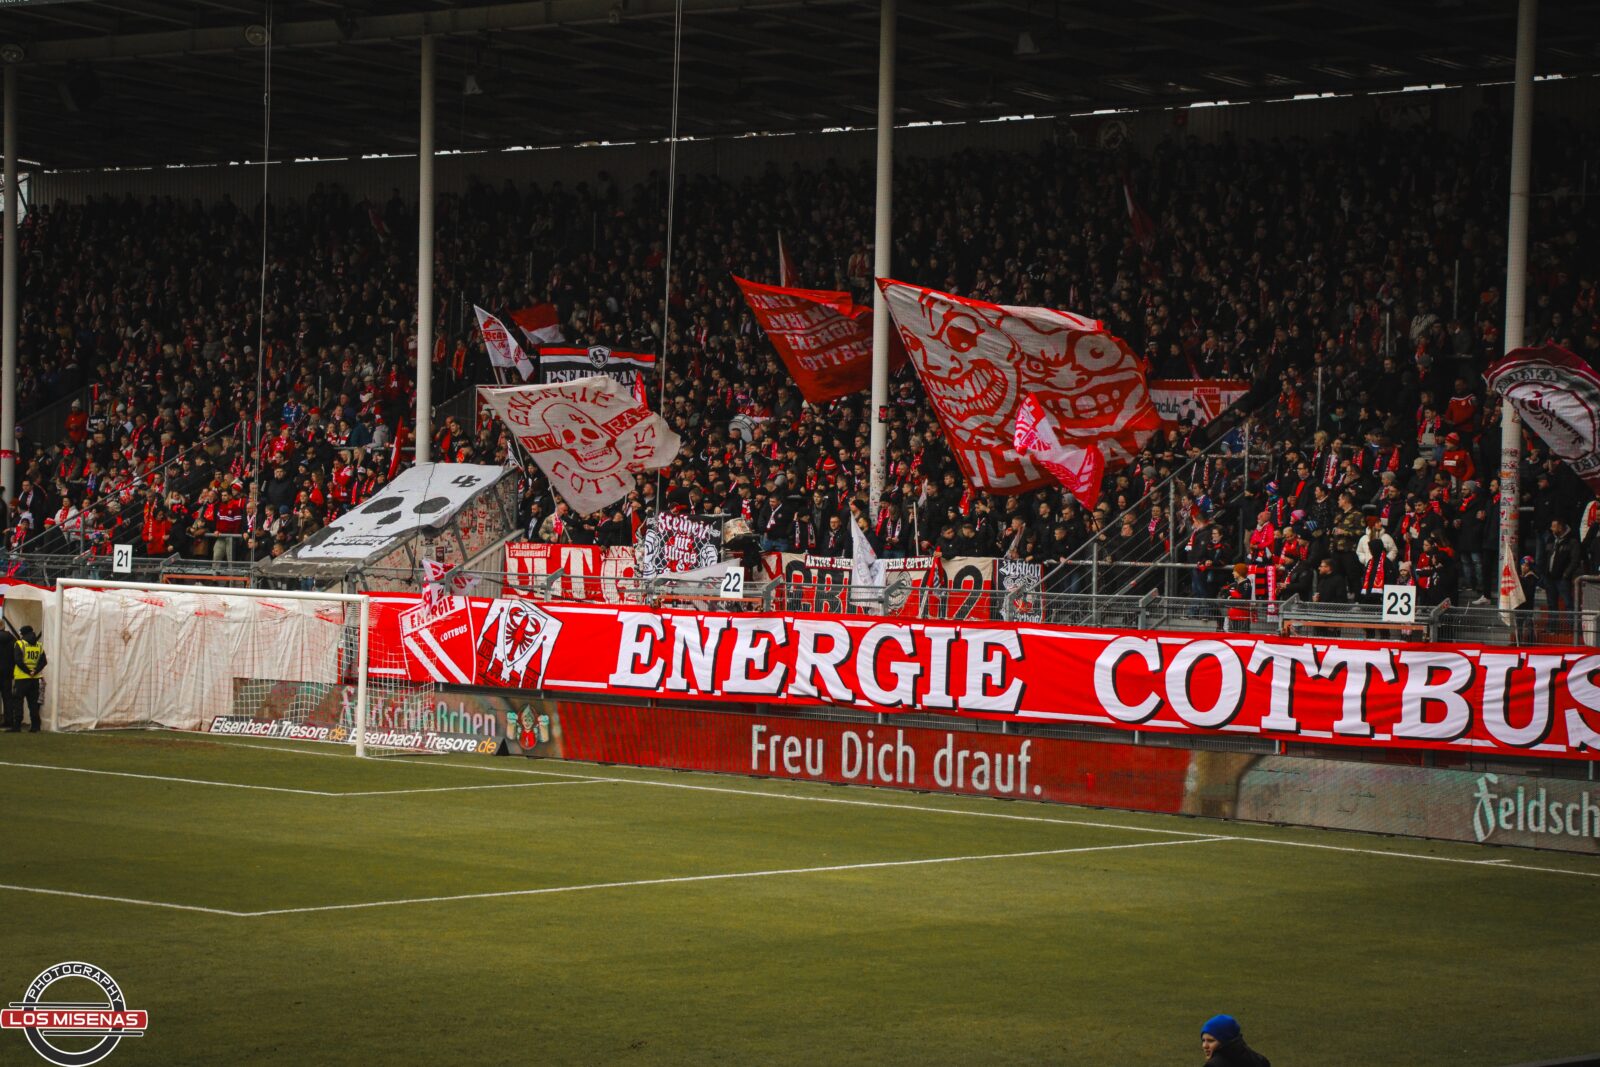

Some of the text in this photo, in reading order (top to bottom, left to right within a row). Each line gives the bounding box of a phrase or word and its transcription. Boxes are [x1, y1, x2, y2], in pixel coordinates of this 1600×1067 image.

[116, 549, 129, 568] 21
[906, 557, 933, 570] COTTBU
[723, 572, 741, 592] 22
[1386, 592, 1412, 616] 23
[440, 624, 468, 643] COTTBUS
[608, 611, 1025, 714] ENERGIE
[339, 685, 496, 737] Fldschlößchen
[210, 717, 278, 737] Eisenbach
[347, 728, 497, 753] Esenbach Tresore.de
[751, 724, 1042, 796] Freu Dich drauf.
